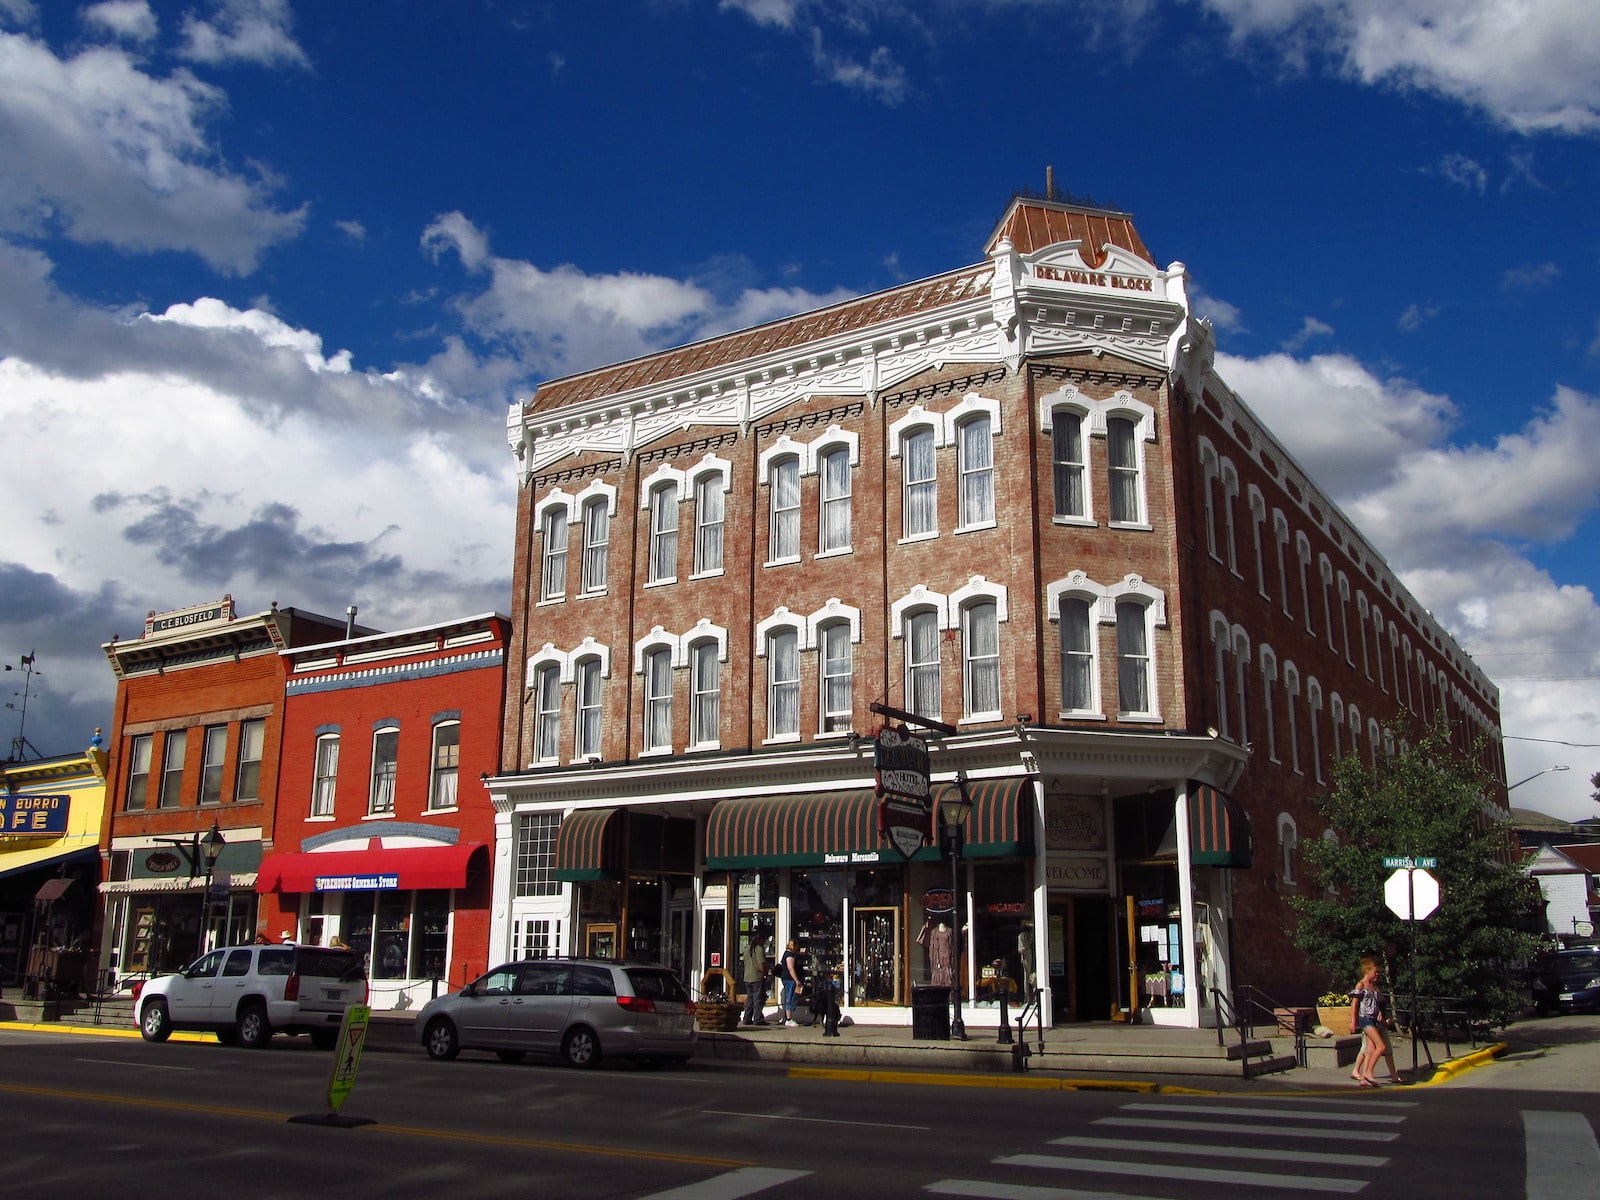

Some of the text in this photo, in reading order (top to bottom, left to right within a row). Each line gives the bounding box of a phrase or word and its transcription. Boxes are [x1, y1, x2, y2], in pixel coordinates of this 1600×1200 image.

[1036, 266, 1153, 292] DELAWARE BLOCK
[174, 610, 214, 627] BLOSFELD
[899, 771, 919, 785] HOTEL
[16, 797, 59, 810] BURRO
[824, 851, 880, 864] Delaware Mercantile
[1422, 858, 1435, 867] AVE
[352, 876, 378, 889] GENERAL
[378, 875, 398, 888] STORE
[920, 893, 953, 908] OPEN
[986, 903, 1026, 913] VACANCY
